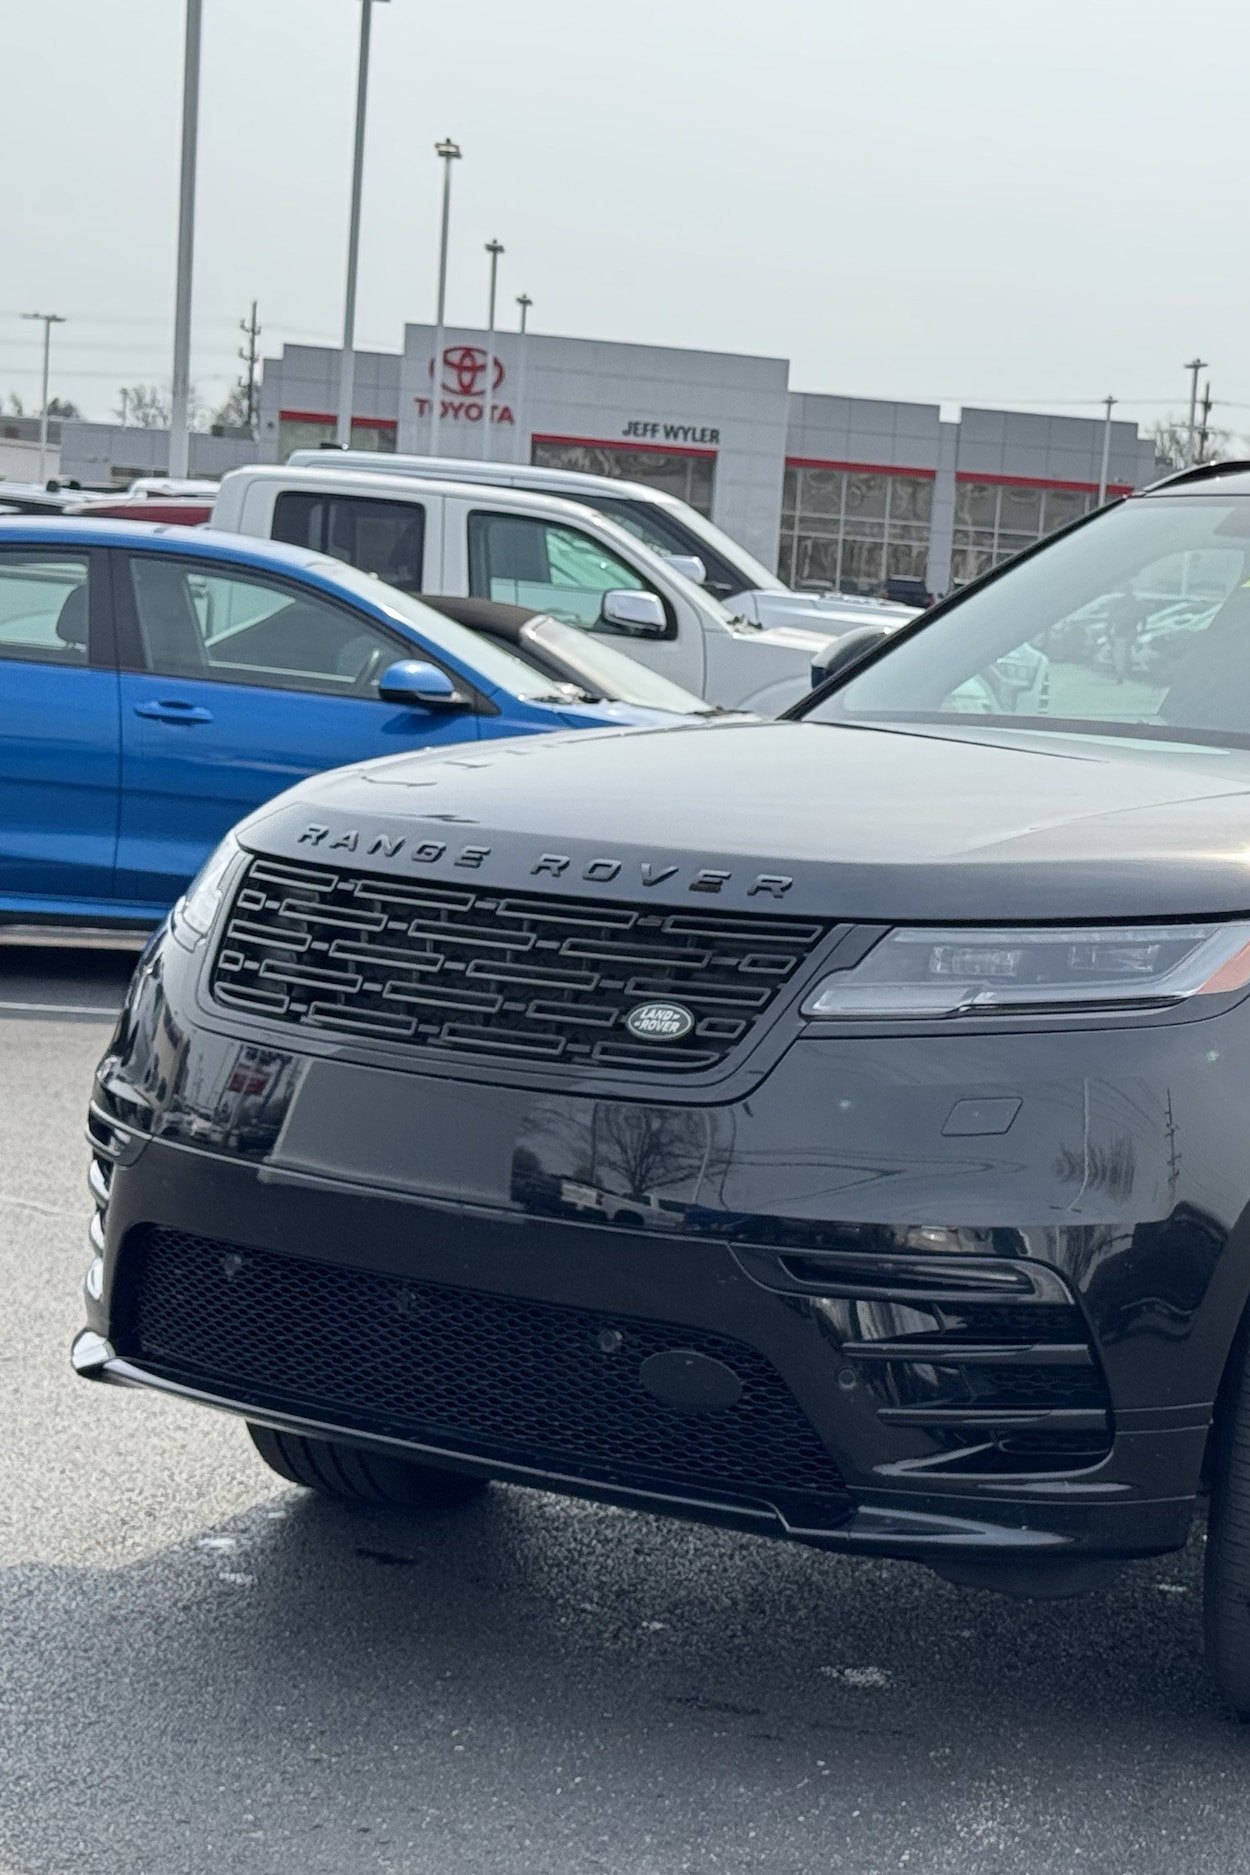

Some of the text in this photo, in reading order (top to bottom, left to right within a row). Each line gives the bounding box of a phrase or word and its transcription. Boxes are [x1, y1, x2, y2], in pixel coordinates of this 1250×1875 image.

[415, 397, 516, 425] TOYOTA
[622, 421, 720, 444] JEFF WYLER
[298, 823, 794, 899] RANGE ROVER
